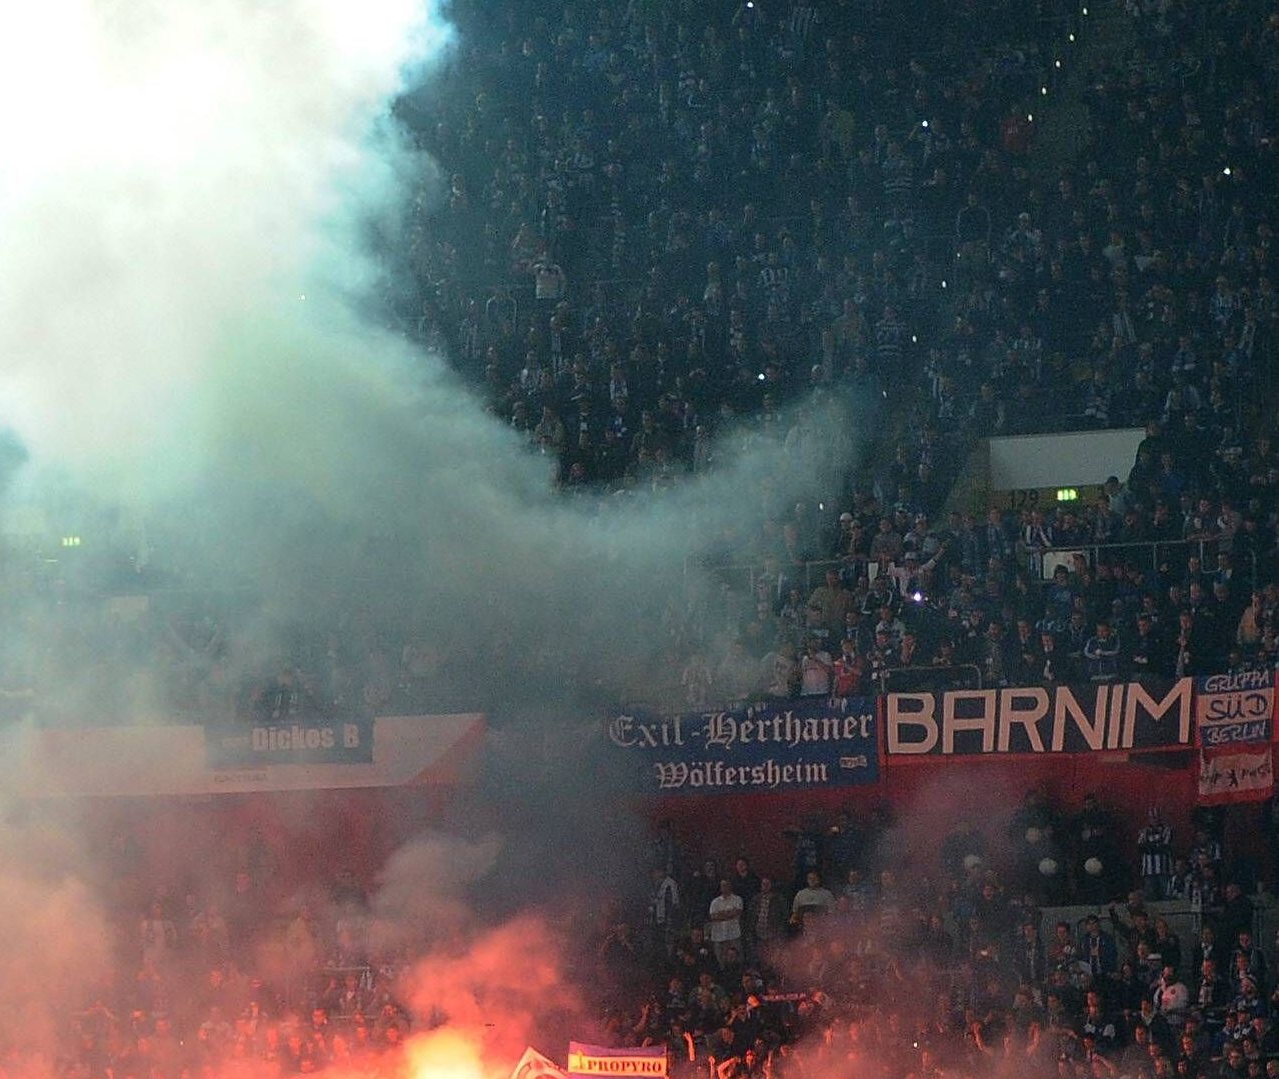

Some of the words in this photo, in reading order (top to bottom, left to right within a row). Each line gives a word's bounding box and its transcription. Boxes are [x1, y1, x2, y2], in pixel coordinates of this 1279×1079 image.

[887, 677, 1193, 754] BARNIM
[1206, 693, 1268, 720] SÜD
[1207, 722, 1267, 743] BERLIN
